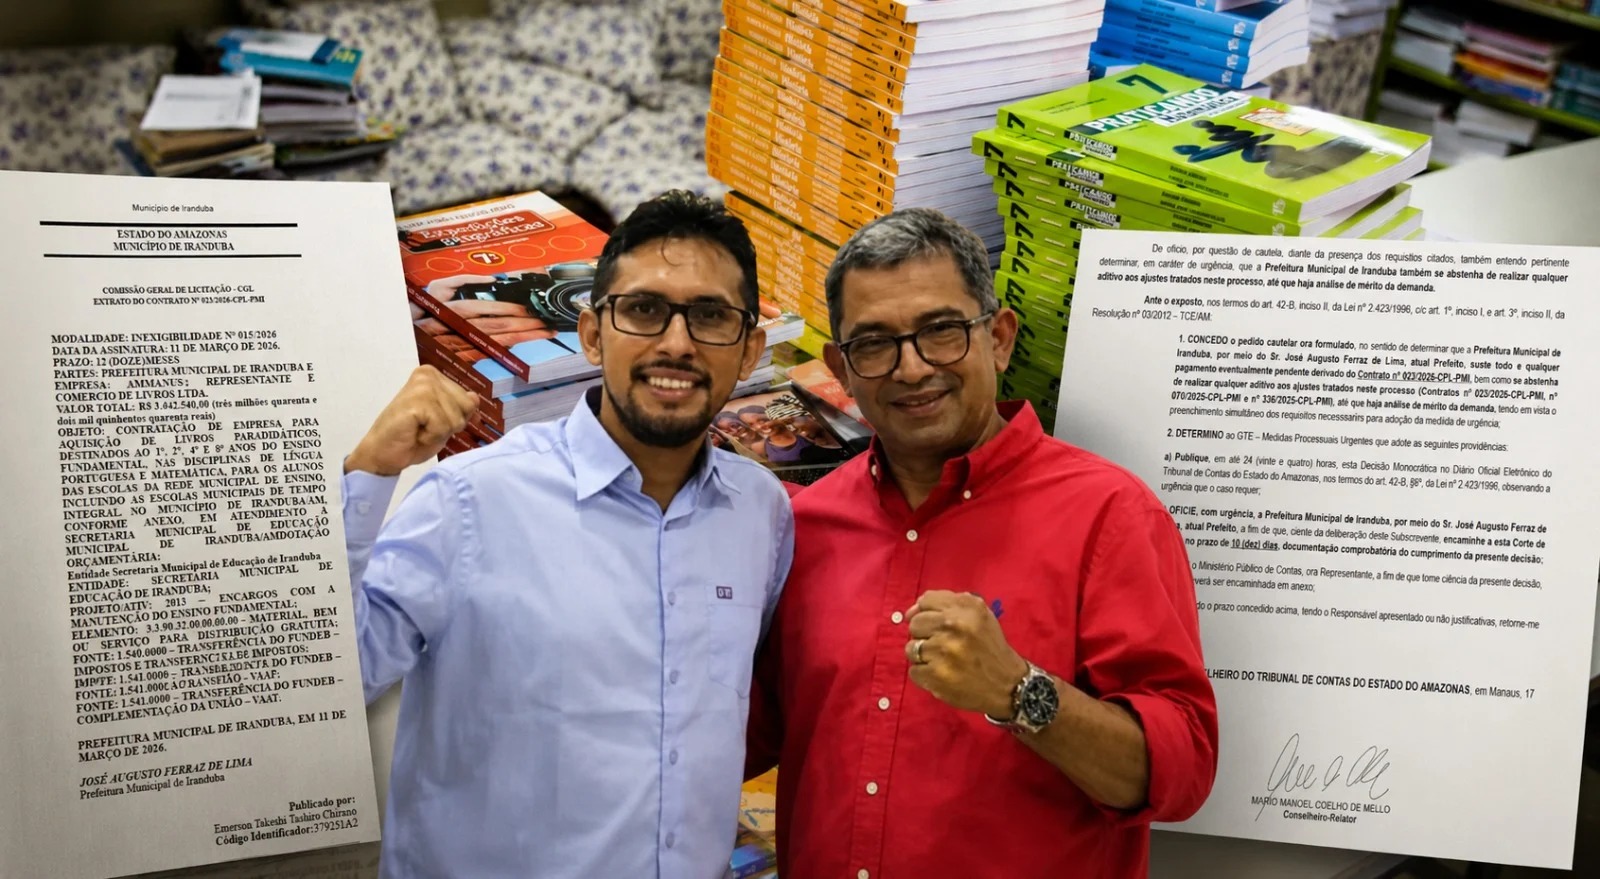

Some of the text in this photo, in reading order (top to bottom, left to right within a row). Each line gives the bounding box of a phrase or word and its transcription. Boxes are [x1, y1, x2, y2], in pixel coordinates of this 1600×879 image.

[1117, 74, 1168, 94] 7
[1084, 88, 1220, 131] PRATICANDO
[1007, 112, 1026, 129] 7
[984, 141, 1004, 158] 7
[998, 162, 1017, 178] 7
[1006, 180, 1024, 197] 7
[1010, 202, 1029, 219] 7
[116, 228, 227, 241] ESTADO DO AMAZONAS
[1015, 222, 1034, 238] 7
[112, 240, 234, 251] MUNICÍPIO DE IRANDUBA
[102, 285, 145, 294] COMISSÃO
[145, 286, 174, 294] GERAL
[174, 285, 186, 293] DE
[187, 284, 231, 293] LICITAÇÃO
[1096, 271, 1435, 292] aditivo aos ajustes tratados neste processo, até que haja análise de mérito da demanda.
[50, 333, 128, 343] MODALIDADE:
[51, 340, 280, 355] DATA DA ASSINATURA: 11 DE MARÇO DE 2026.
[52, 356, 93, 367] PRAZO:
[96, 356, 106, 366] 12
[1176, 347, 1212, 359] Iranduba,
[1216, 351, 1230, 360] por
[1233, 350, 1252, 359] meio
[1255, 351, 1266, 360] do
[1269, 351, 1280, 360] Sr.
[1284, 352, 1303, 362] José
[1306, 352, 1340, 364] Augusto
[1342, 354, 1368, 364] Ferraz
[1371, 355, 1381, 365] de
[1384, 356, 1406, 366] Lima,
[1410, 357, 1430, 367] atual
[1432, 357, 1466, 368] Prefeito,
[1469, 360, 1492, 369] suste
[1494, 360, 1512, 370] todo
[1524, 362, 1560, 373] qualquer
[53, 362, 313, 379] PARTES: PREFEITURA MUNICIPAL DE IRANDUBA E
[117, 390, 133, 400] DE
[134, 389, 175, 399] LIVROS
[176, 388, 208, 398] LTDA.
[62, 483, 326, 508] INCLUINDO AS ESCOLAS MUNICIPAIS DE TEMPO
[1160, 481, 1192, 492] urgência
[1193, 484, 1208, 493] que
[1215, 485, 1234, 493] caso
[1234, 485, 1260, 495] requer;
[1196, 538, 1218, 547] prazo
[1219, 537, 1229, 547] de
[1232, 538, 1240, 548] 10
[1242, 539, 1261, 550] (dez)
[1262, 540, 1280, 551] dias,
[1281, 540, 1338, 552] documentação
[1398, 546, 1409, 556] do
[1410, 549, 1462, 559] cumprimento
[1463, 550, 1473, 560] da
[1474, 553, 1509, 562] presente
[1510, 553, 1543, 564] decisão;
[1205, 668, 1534, 698] LHEIRO DO TRIBUNAL DE CONTAS DO ESTADO DO AMAZONAS, em Manaus, 17
[77, 709, 346, 750] PREFEITURA MUNICIPAL DE IRANDUBA, EM 11 DE
[78, 742, 166, 762] MARÇO DE 2026.
[108, 767, 162, 784] AUGUSTO
[163, 761, 206, 776] FERRAZ
[207, 759, 223, 771] DE
[224, 756, 252, 769] LIMA
[79, 772, 225, 800] Prefeitura Municipal de Iranduba
[288, 796, 355, 812] Publicado por:
[1280, 798, 1313, 809] MANOEL
[1315, 800, 1348, 810] COELHO
[1350, 802, 1361, 812] DE
[1363, 804, 1390, 814] MELLO
[213, 822, 252, 834] Emerson
[288, 811, 321, 823] Tashiro
[1283, 810, 1356, 824] Conselheiro-Relator
[215, 833, 248, 846] Código
